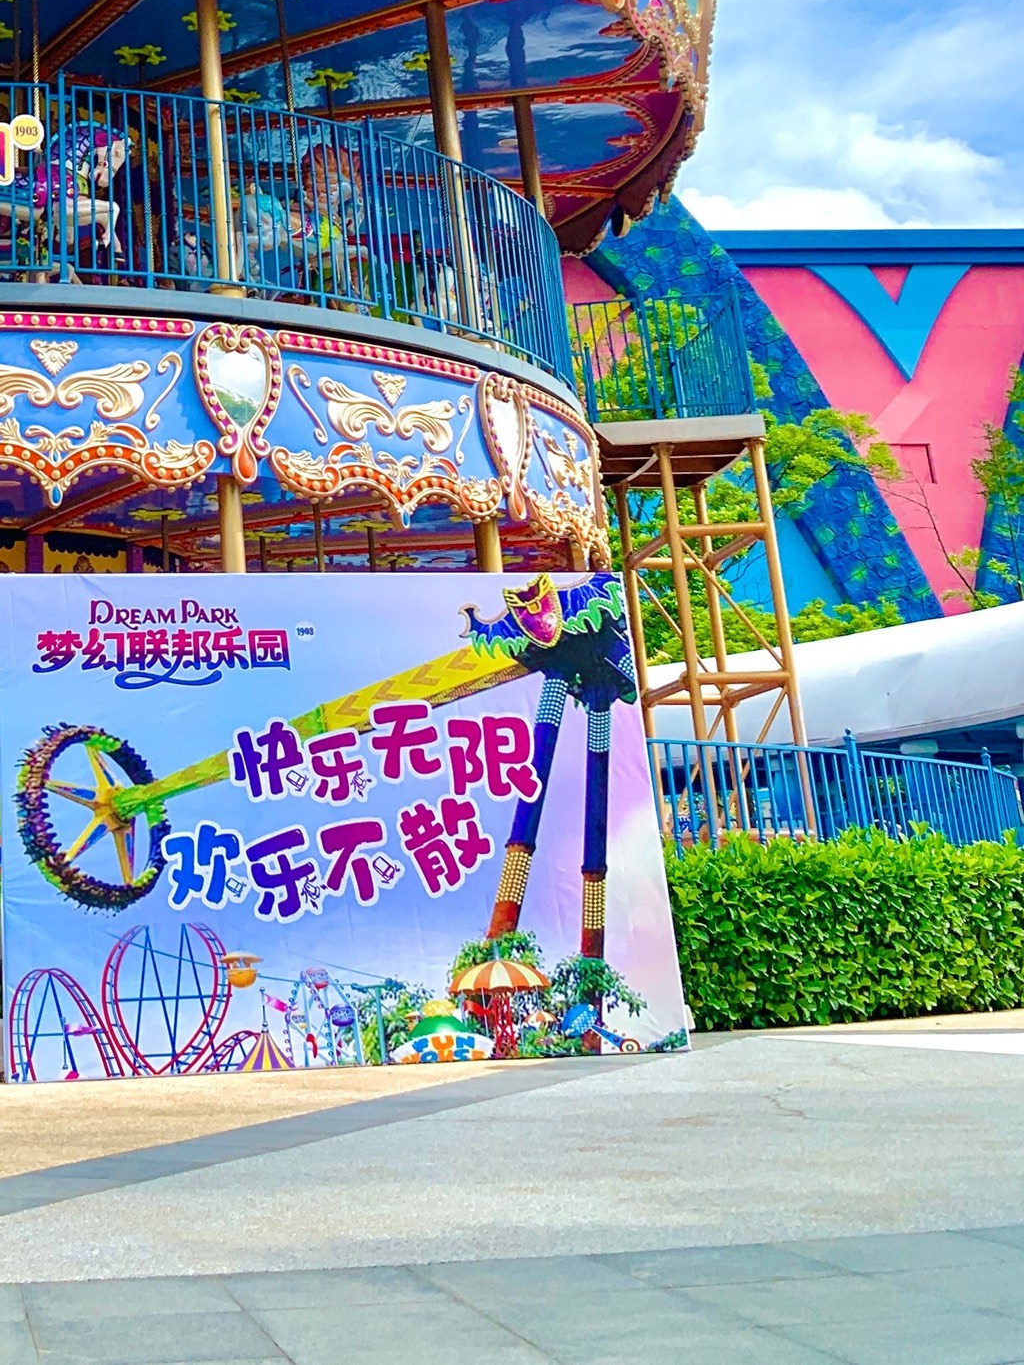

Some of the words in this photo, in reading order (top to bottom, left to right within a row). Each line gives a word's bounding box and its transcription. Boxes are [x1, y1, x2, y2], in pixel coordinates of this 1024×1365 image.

[14, 125, 39, 137] 1903
[88, 600, 176, 629] DREAM
[180, 600, 239, 629] PARK
[32, 627, 291, 689] 梦幻联邦乐园
[233, 704, 542, 801] 快乐无限
[165, 798, 491, 918] 欢乐不散
[412, 1035, 475, 1053] FUN
